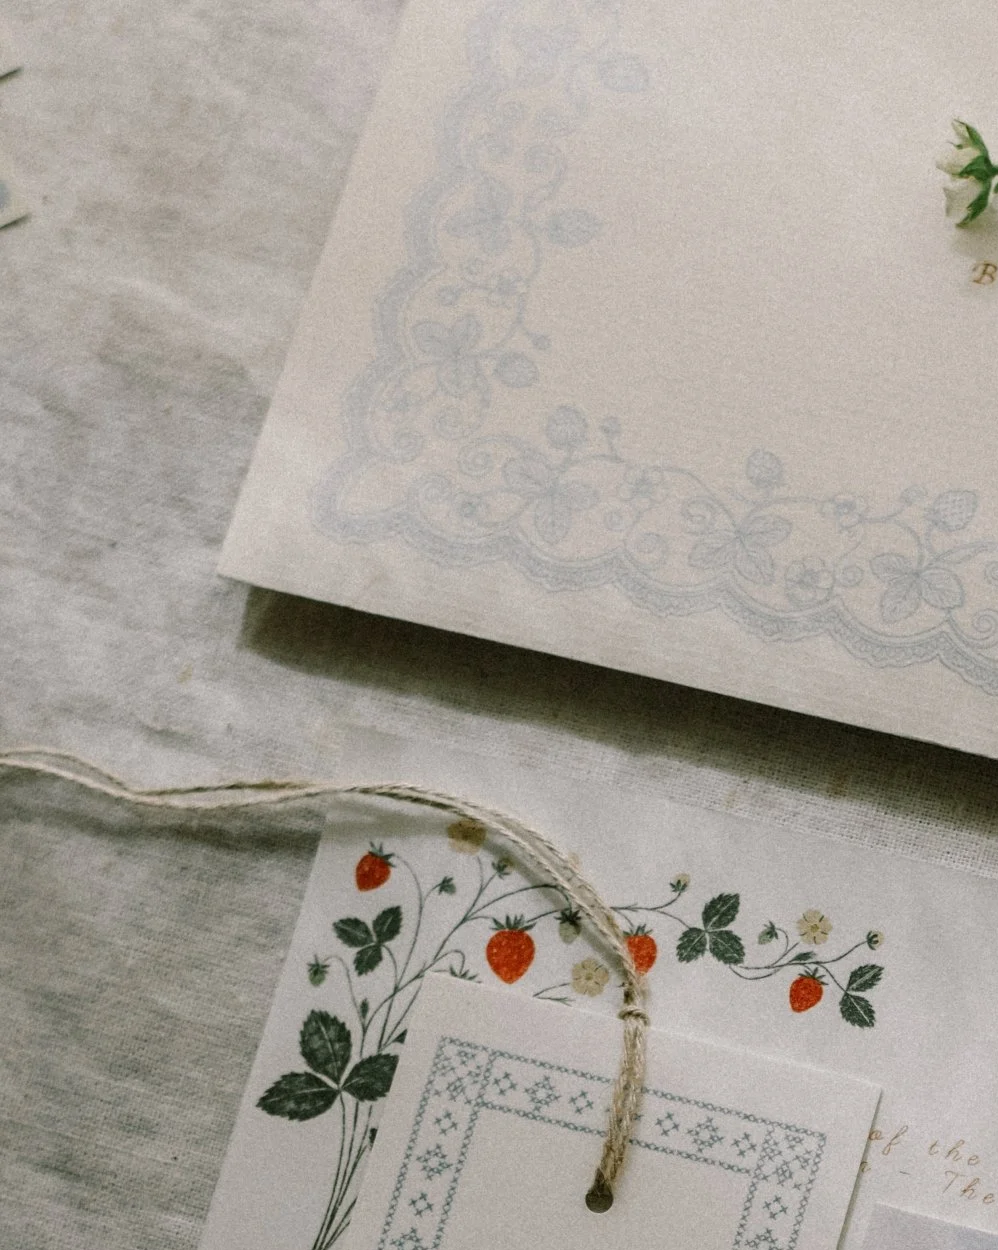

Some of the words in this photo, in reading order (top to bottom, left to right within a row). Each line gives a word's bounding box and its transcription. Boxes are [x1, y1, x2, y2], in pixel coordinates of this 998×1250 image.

[867, 1125, 909, 1156] of
[927, 1139, 981, 1168] the
[941, 1170, 997, 1205] The
